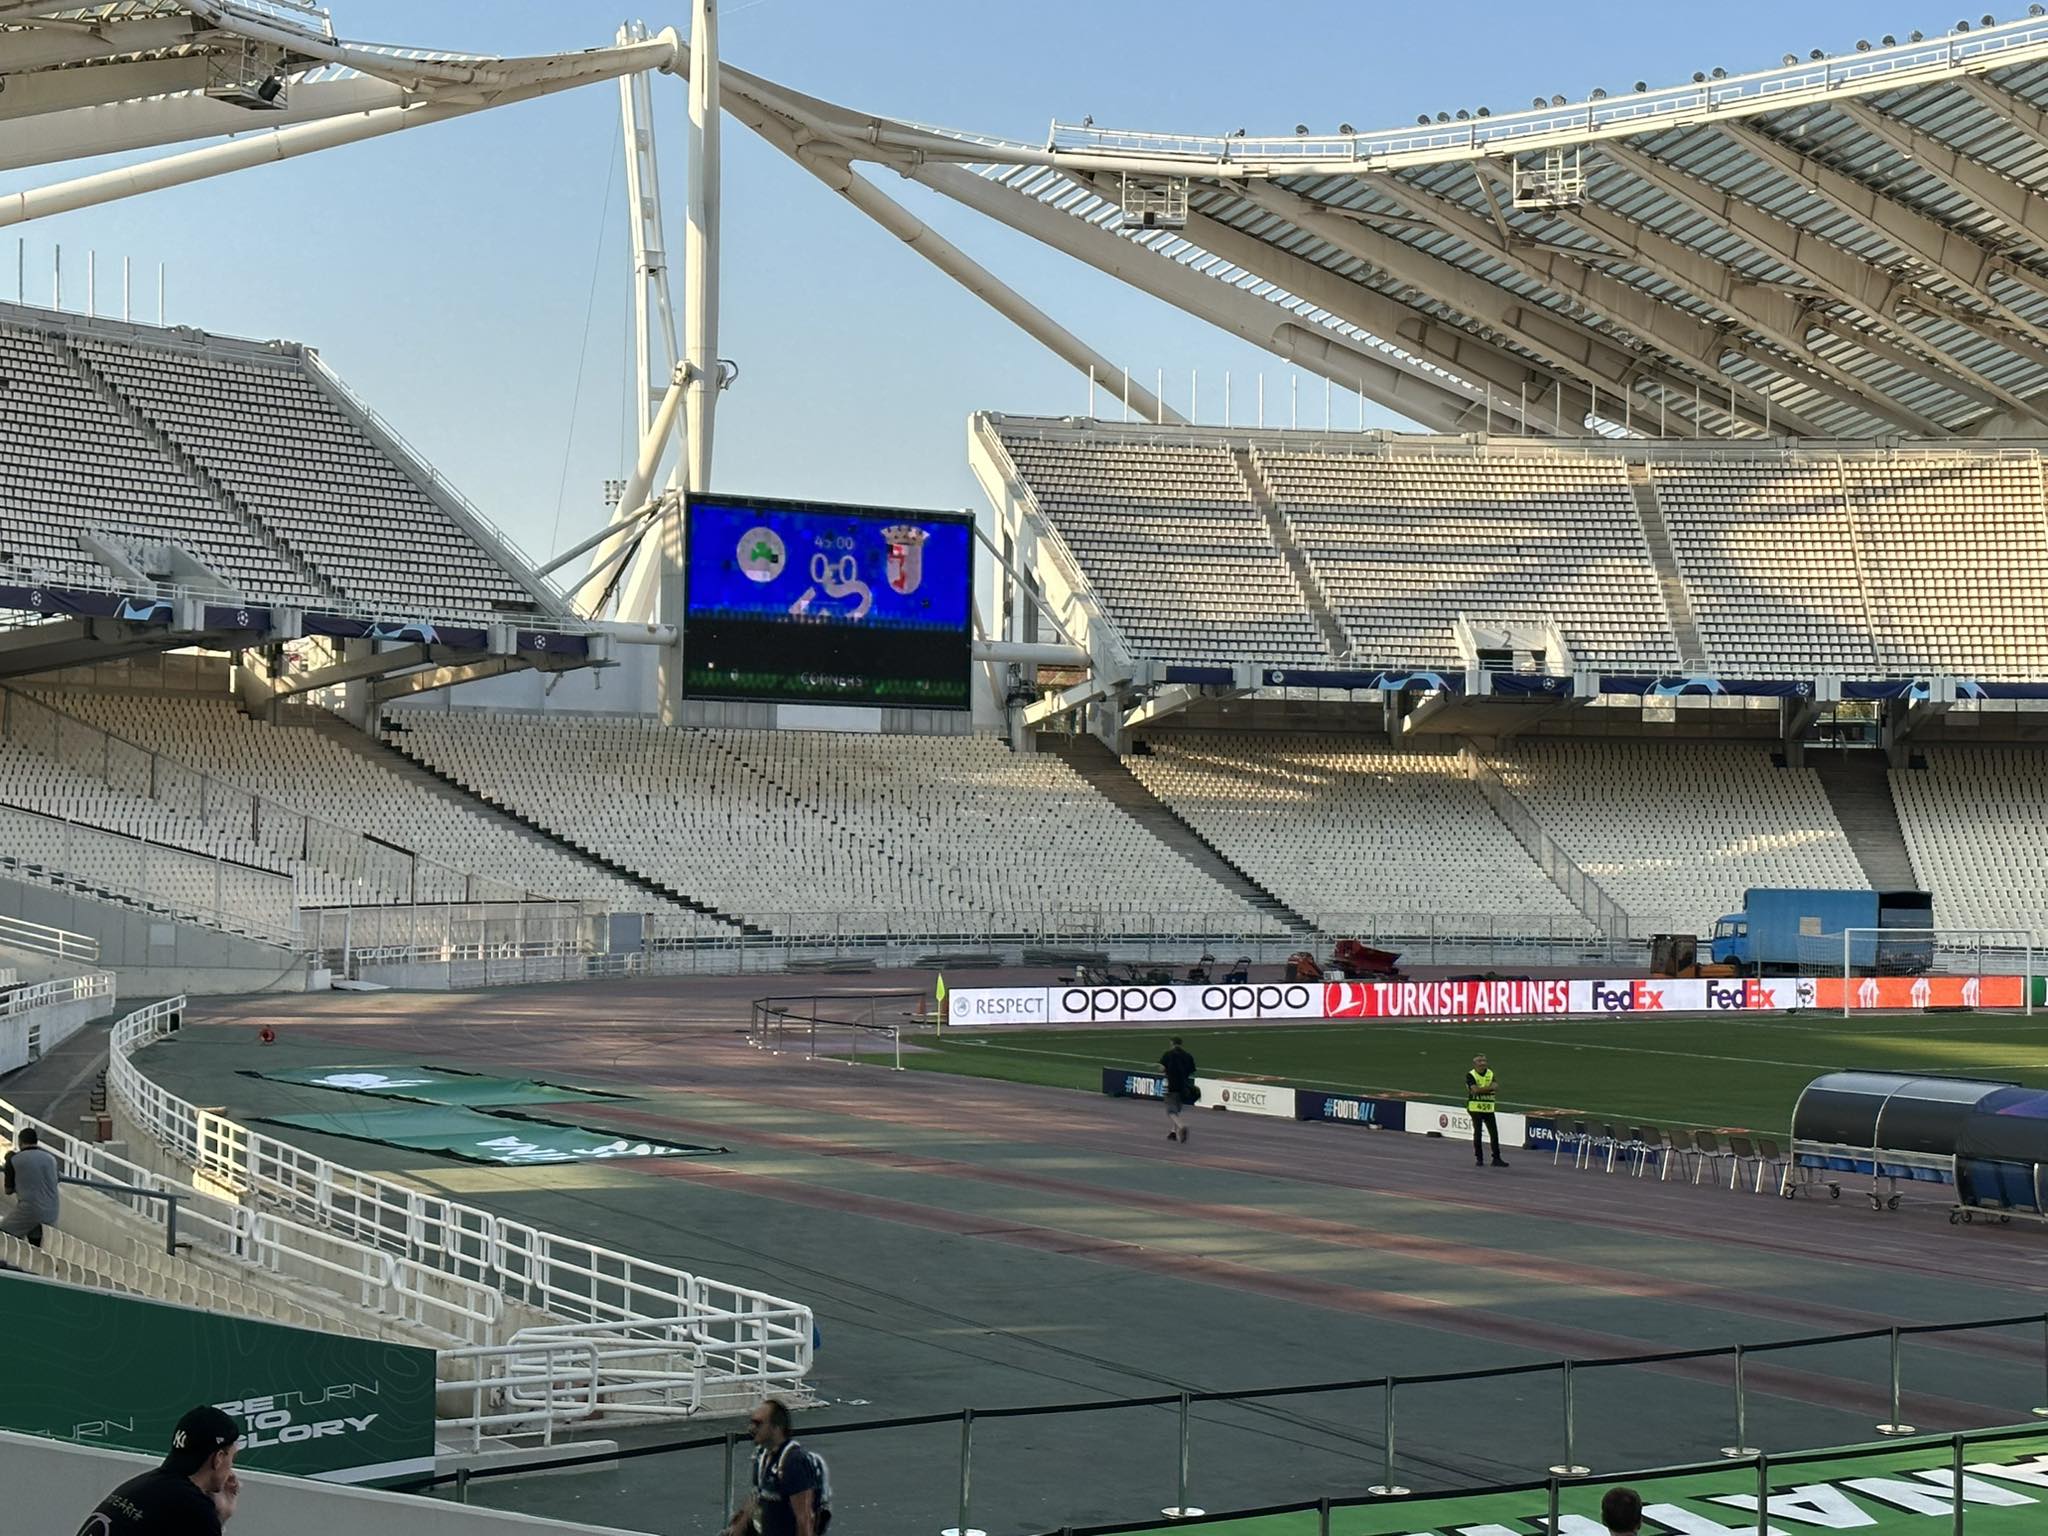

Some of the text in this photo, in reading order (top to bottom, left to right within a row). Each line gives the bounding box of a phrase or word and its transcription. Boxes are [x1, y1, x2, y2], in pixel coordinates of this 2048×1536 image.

[1501, 630, 1513, 648] 2
[800, 671, 863, 687] CORNERS
[975, 997, 1044, 1015] RESPECT
[1061, 987, 1177, 1021] oppo
[1201, 985, 1310, 1018] oppo
[1374, 980, 1568, 1016] TURKISH AIRLINES
[1591, 980, 1664, 1011] FedEx
[1706, 979, 1776, 1009] FedEx
[1232, 1090, 1268, 1106] RESPECT
[1529, 1126, 1554, 1140] UEFA
[211, 1379, 379, 1416] RETURN
[245, 1409, 292, 1432] TO
